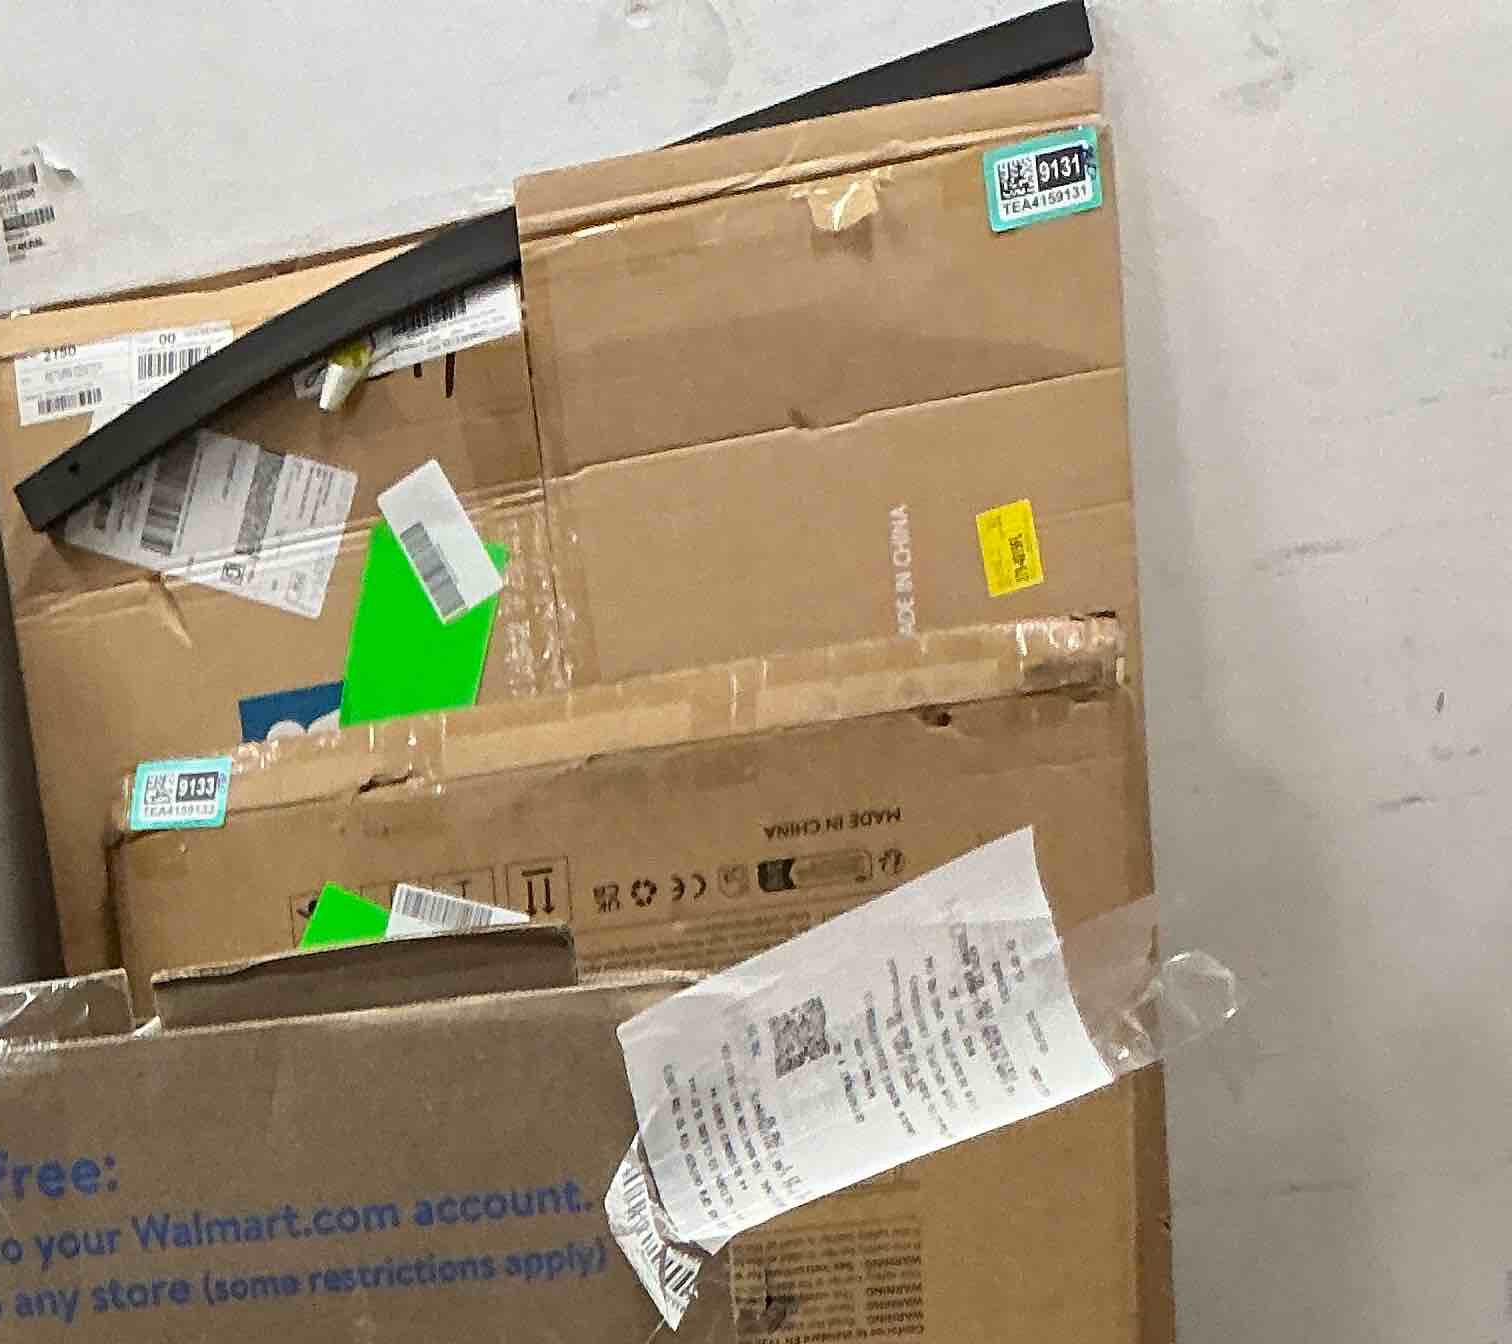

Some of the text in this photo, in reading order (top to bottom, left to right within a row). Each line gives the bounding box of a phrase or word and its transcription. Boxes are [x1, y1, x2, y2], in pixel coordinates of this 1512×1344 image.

[1038, 152, 1081, 183] 9131
[1000, 184, 1088, 216] TEA4159131
[178, 776, 216, 798] 9133
[763, 806, 901, 842] MADE IN CHINA
[33, 1227, 122, 1272] your
[131, 1200, 401, 1252] Walmart.com
[413, 1178, 592, 1227] account.
[14, 1285, 81, 1324] any
[91, 1277, 192, 1314] store
[203, 1271, 299, 1305] (some
[309, 1254, 497, 1295] restrictions
[504, 1237, 607, 1283] apply)
